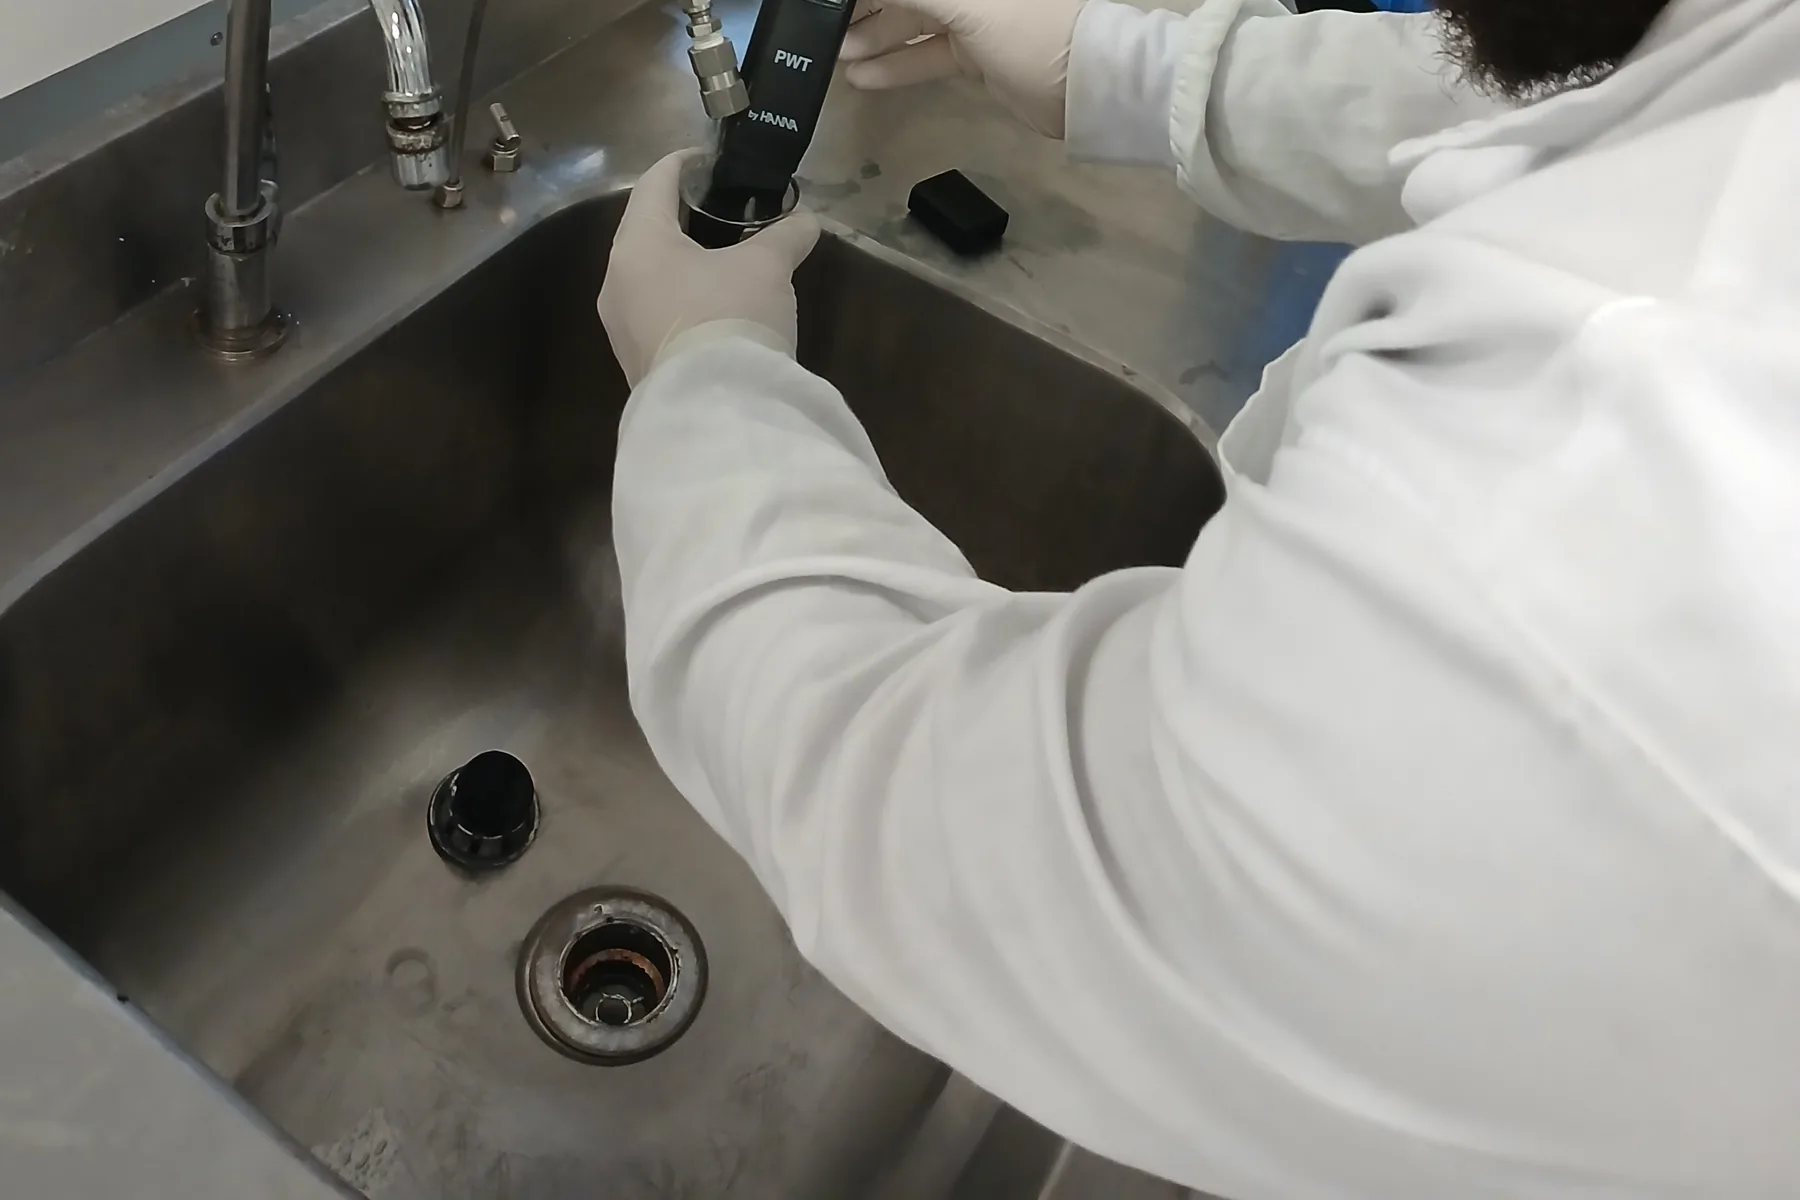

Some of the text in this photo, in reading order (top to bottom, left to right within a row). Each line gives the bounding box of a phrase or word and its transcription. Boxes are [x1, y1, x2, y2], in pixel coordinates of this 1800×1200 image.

[774, 49, 813, 72] PWT
[747, 109, 798, 132] by HANNA
